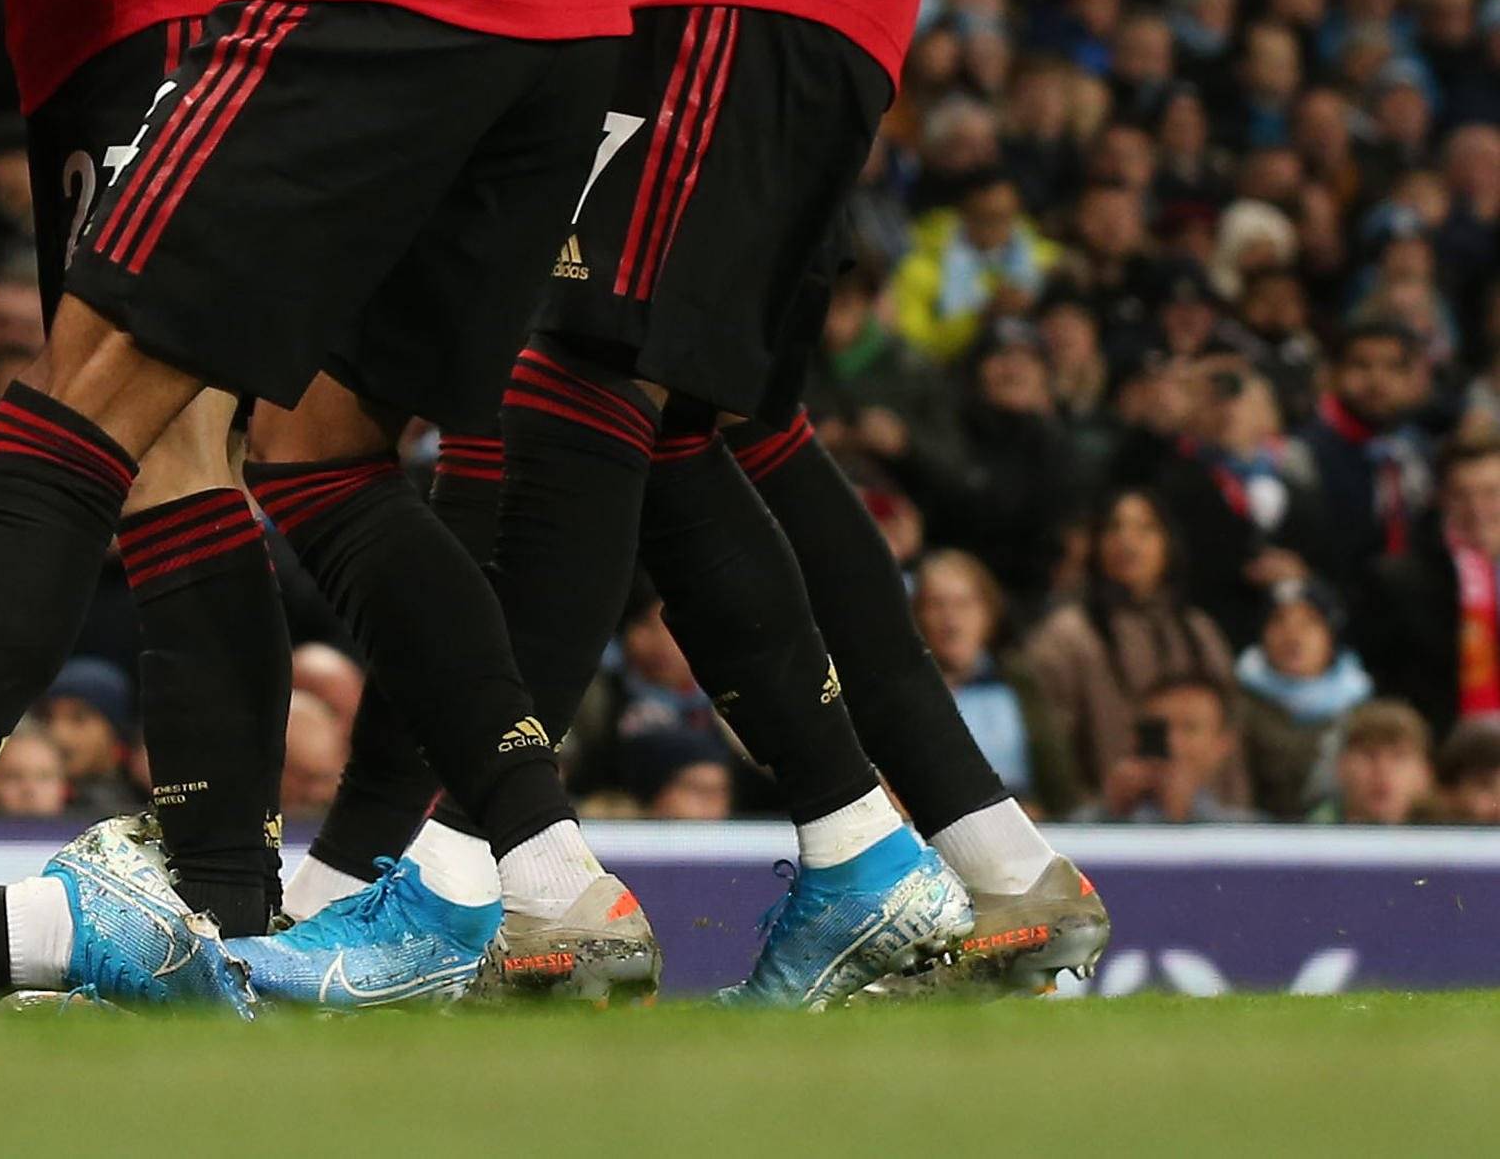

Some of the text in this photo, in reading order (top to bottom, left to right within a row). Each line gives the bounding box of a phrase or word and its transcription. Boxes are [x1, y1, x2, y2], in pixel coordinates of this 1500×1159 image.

[571, 111, 647, 225] 7
[62, 149, 99, 271] 2
[504, 953, 573, 972] NEMESIS
[962, 924, 1047, 951] NEMESIS
